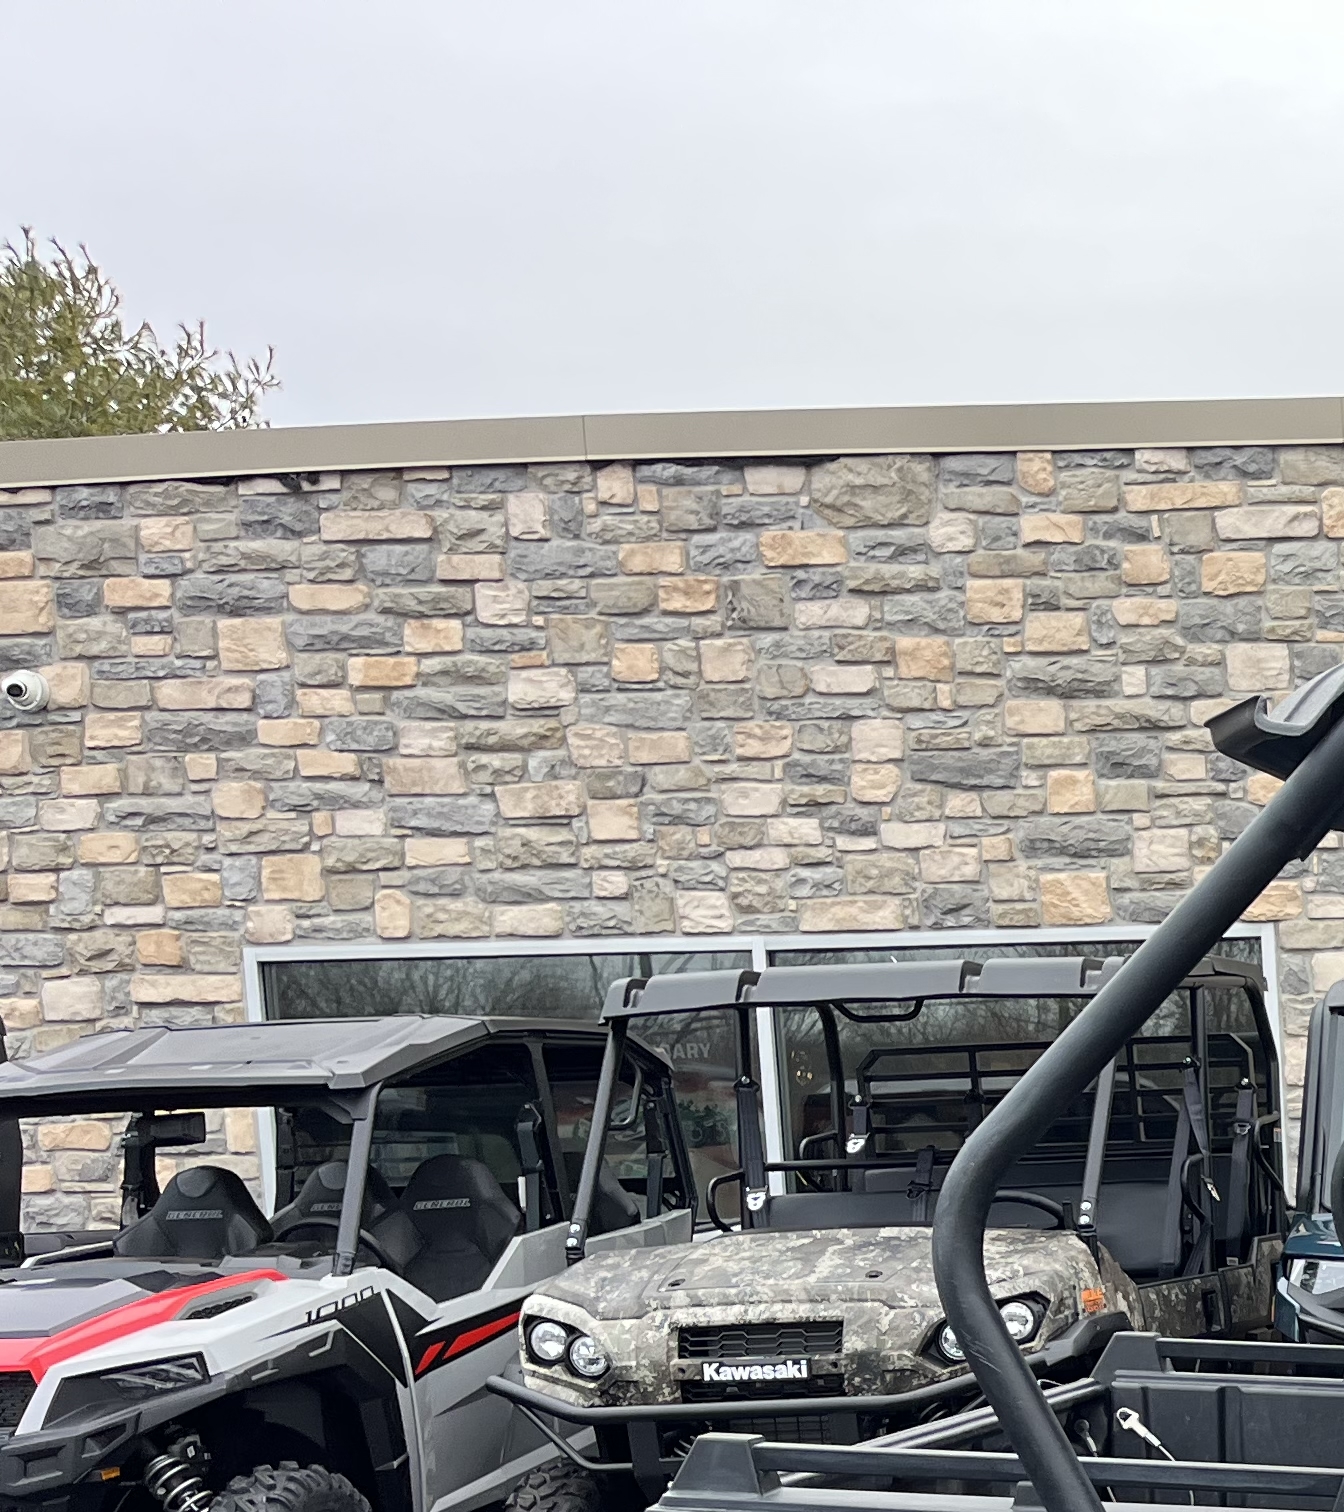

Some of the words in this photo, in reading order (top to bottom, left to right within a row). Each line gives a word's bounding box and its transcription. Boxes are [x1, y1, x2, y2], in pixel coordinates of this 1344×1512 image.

[166, 1208, 223, 1221] GENERAL
[305, 1285, 377, 1325] 1000
[702, 1360, 808, 1381] Kawasaki
